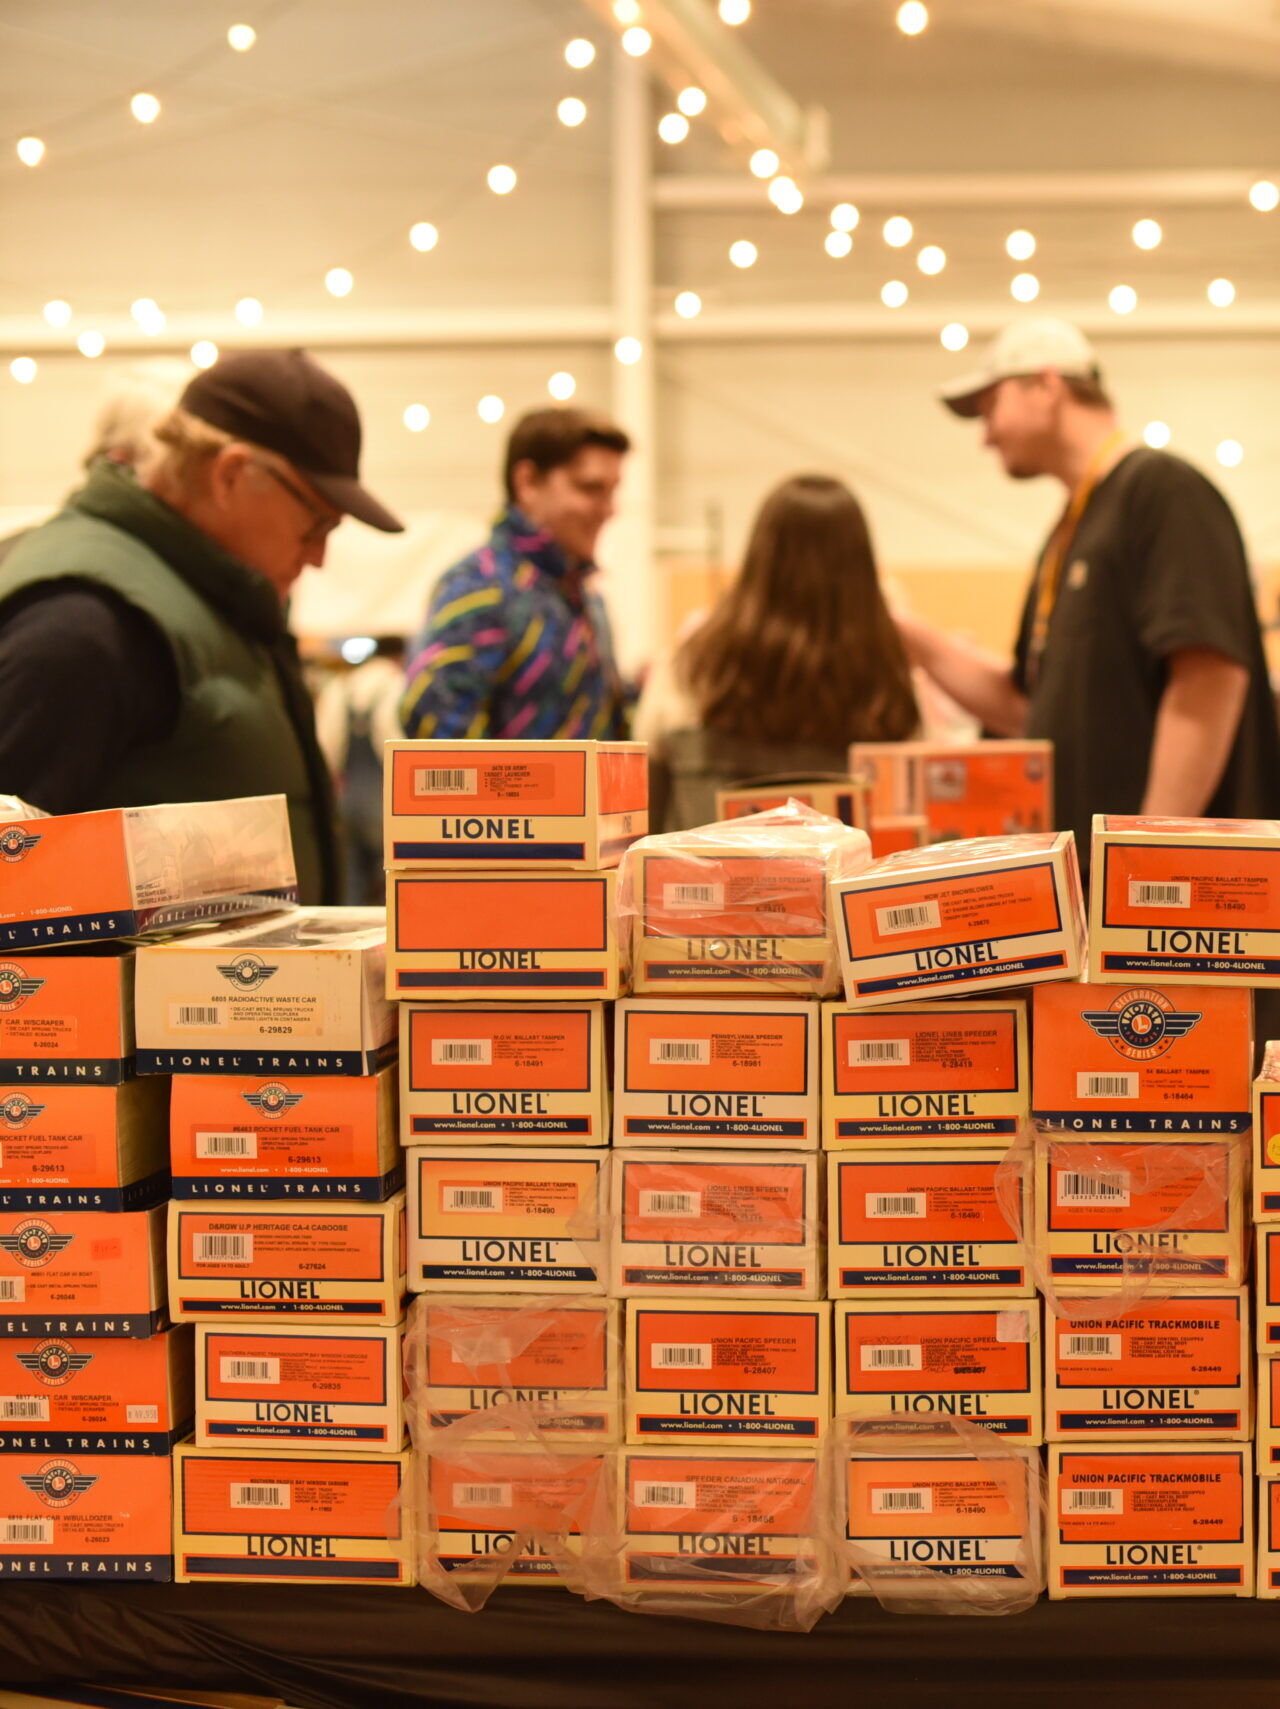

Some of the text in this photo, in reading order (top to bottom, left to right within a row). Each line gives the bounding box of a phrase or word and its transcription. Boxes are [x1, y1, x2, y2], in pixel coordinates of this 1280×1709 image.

[442, 819, 534, 839] LIONEL
[32, 920, 116, 937] TRAINS
[1147, 931, 1245, 954] LIONEL
[459, 951, 540, 969] LIONEL
[914, 942, 998, 971] LIONEL
[1127, 960, 1265, 970] www.lionel.com 1-800-4LIONEL
[897, 962, 1024, 987] www.lionel.com 1-800-4LIONEL
[156, 1056, 343, 1067] LIONEL TRAINS
[17, 1066, 102, 1076] TRAINS
[453, 1093, 547, 1114] LIONEL
[668, 1095, 762, 1117] LIONEL
[878, 1095, 974, 1117] LIONEL
[1046, 1119, 1237, 1130] LIONEL TRAINS
[192, 1184, 361, 1193] LIONEL TRAINS
[27, 1195, 102, 1204] TRAINS
[462, 1242, 556, 1262] LIONEL
[1093, 1233, 1183, 1254] LIONEL
[665, 1245, 761, 1267] LIONEL
[883, 1245, 979, 1267] LIONEL
[864, 1273, 999, 1282] www.lionel.com 1-800-4LIONEL
[240, 1281, 319, 1299] LIONEL
[221, 1303, 344, 1311] www.lionel.com 1-800-4LIONEL
[45, 1322, 130, 1332] TRAINS
[1070, 1320, 1220, 1329] UNION PACIFIC TRACKMOBILE
[744, 1367, 776, 1375] 6-28407
[680, 1394, 775, 1415] LIONEL
[891, 1396, 987, 1415] LIONEL
[1103, 1390, 1194, 1409] LIONEL
[256, 1404, 333, 1423] LIONEL
[1085, 1417, 1214, 1426] www.lionel.com 1-800-4LIONEL
[237, 1426, 357, 1436] www.lionel.com 1-800-4LIONEL
[661, 1422, 795, 1430] www.lionel.com 1-800-4LIONEL
[67, 1439, 150, 1448] TRAINS
[685, 1475, 720, 1483] SPEEDER
[1072, 1474, 1221, 1483] UNION PACIFIC TRACKMOBILE
[247, 1537, 336, 1557] LIONEL
[678, 1536, 770, 1555] LIONEL
[891, 1540, 986, 1561] LIONEL
[1107, 1545, 1198, 1565] LIONEL
[67, 1562, 152, 1572] TRAINS
